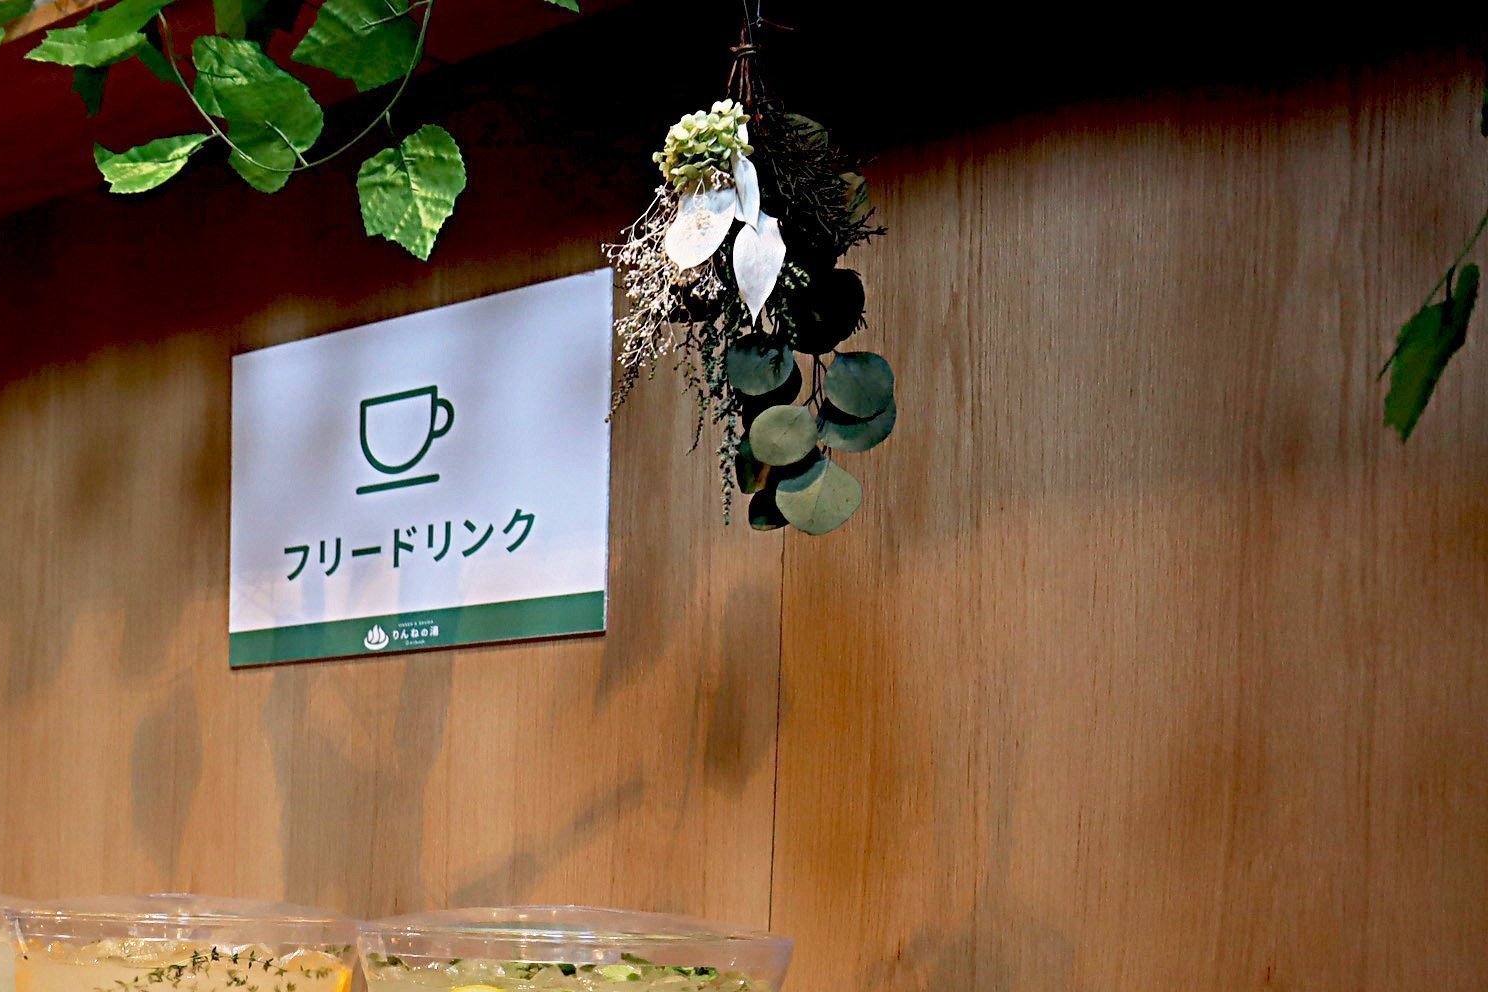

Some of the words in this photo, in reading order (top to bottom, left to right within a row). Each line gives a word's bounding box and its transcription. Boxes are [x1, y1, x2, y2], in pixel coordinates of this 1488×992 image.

[283, 508, 536, 581] フリードリンク
